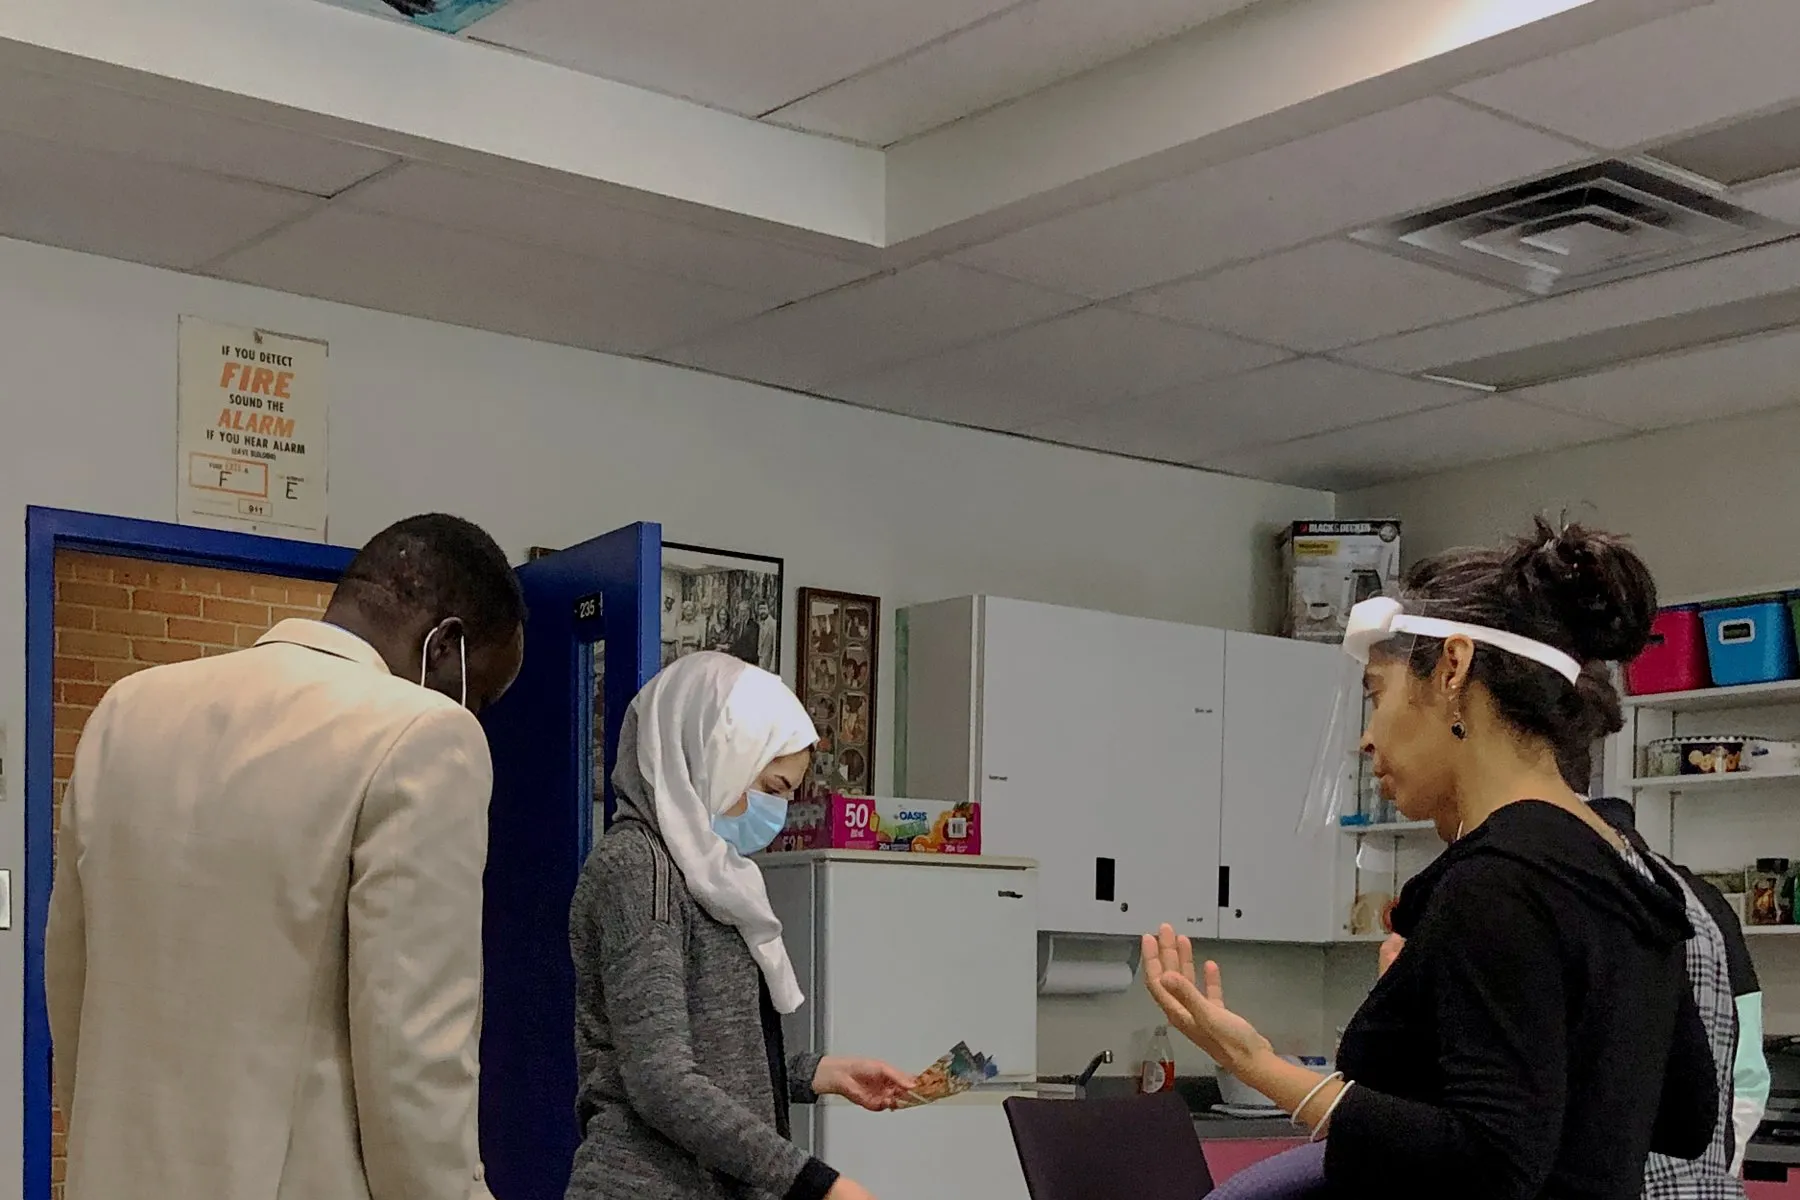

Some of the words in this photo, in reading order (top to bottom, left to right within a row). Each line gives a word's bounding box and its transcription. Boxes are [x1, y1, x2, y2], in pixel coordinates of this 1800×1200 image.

[221, 345, 231, 356] IF
[235, 347, 256, 361] YOU
[259, 351, 293, 367] DETECT
[219, 361, 296, 399] FIRE
[229, 394, 263, 409] SOUND
[267, 400, 284, 413] THE
[217, 408, 296, 438] ALARM
[206, 430, 215, 440] IF
[219, 431, 240, 444] YOU
[244, 436, 269, 449] HEAR
[273, 441, 305, 454] ALARM
[219, 470, 232, 487] F
[286, 481, 298, 500] E
[580, 599, 595, 619] 235
[844, 803, 869, 828] 50
[899, 811, 928, 821] OASIS
